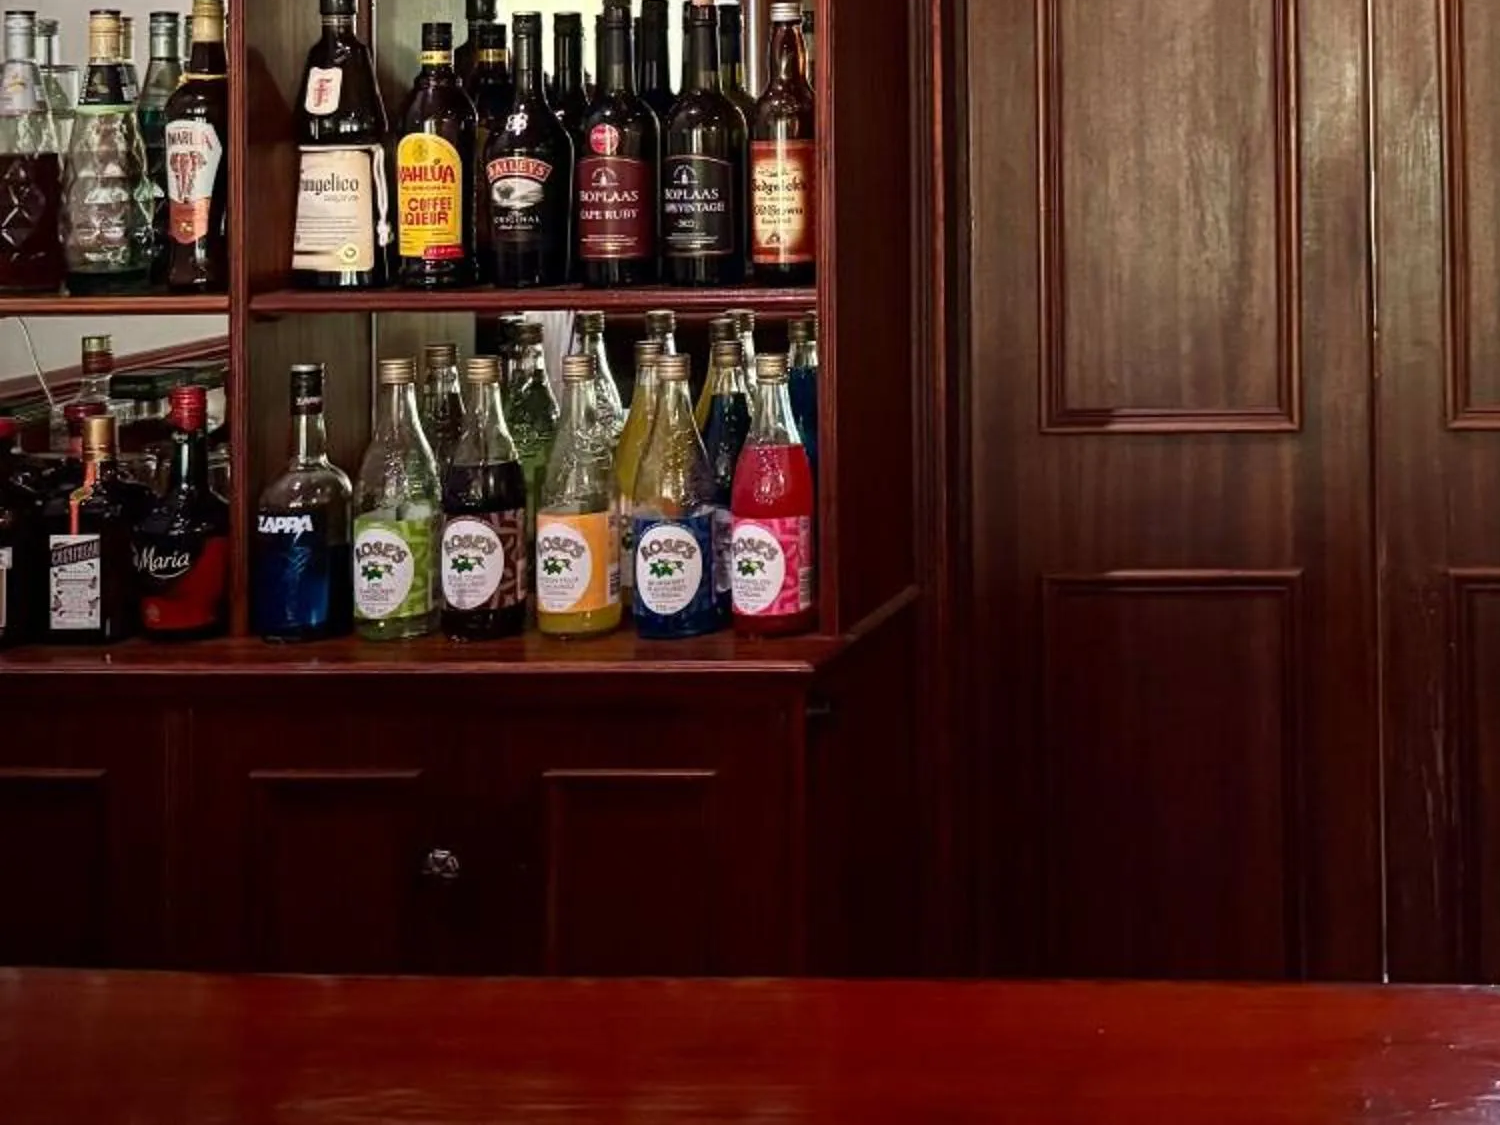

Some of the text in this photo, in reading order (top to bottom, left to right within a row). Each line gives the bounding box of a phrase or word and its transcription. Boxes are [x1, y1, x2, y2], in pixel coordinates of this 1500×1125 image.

[579, 189, 640, 203] BOPLAAS
[408, 197, 453, 212] COFFEE
[139, 545, 191, 573] Maria
